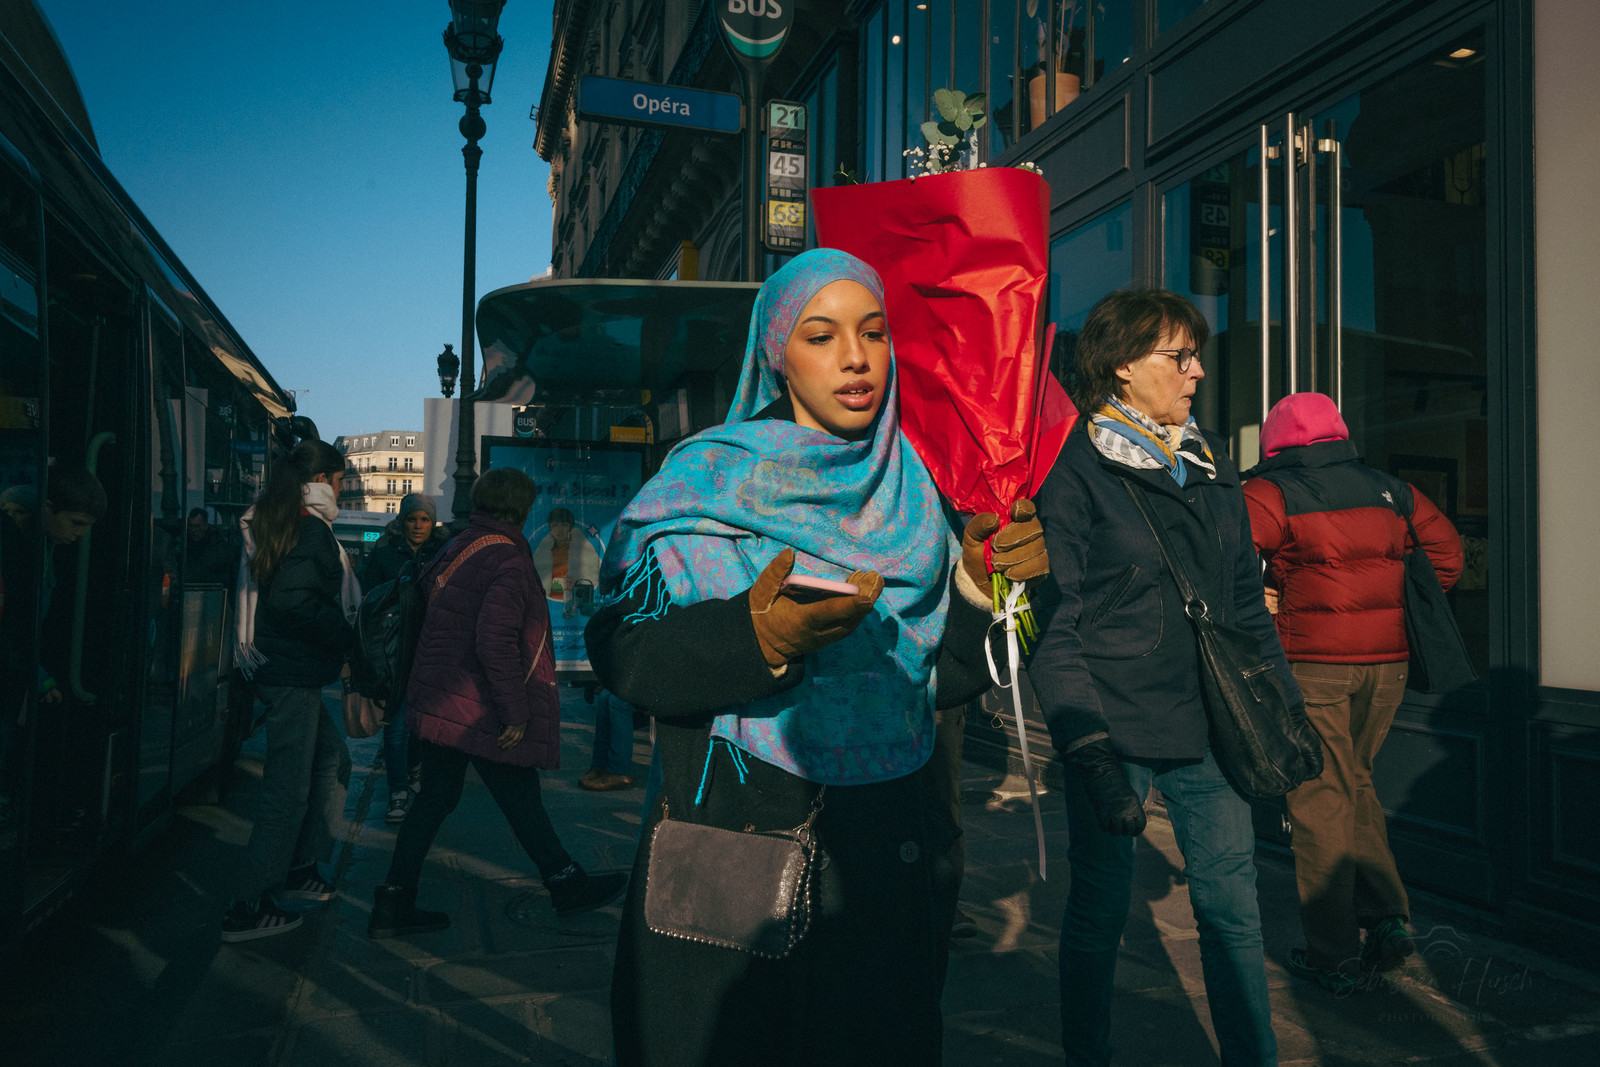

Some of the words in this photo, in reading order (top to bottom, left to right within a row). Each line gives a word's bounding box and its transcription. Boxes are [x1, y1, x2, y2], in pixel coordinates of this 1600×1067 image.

[728, 0, 782, 19] BUS
[633, 93, 690, 116] Opéra
[776, 106, 799, 128] 21
[773, 155, 800, 176] 45
[773, 204, 799, 225] 68
[517, 417, 535, 427] BUS
